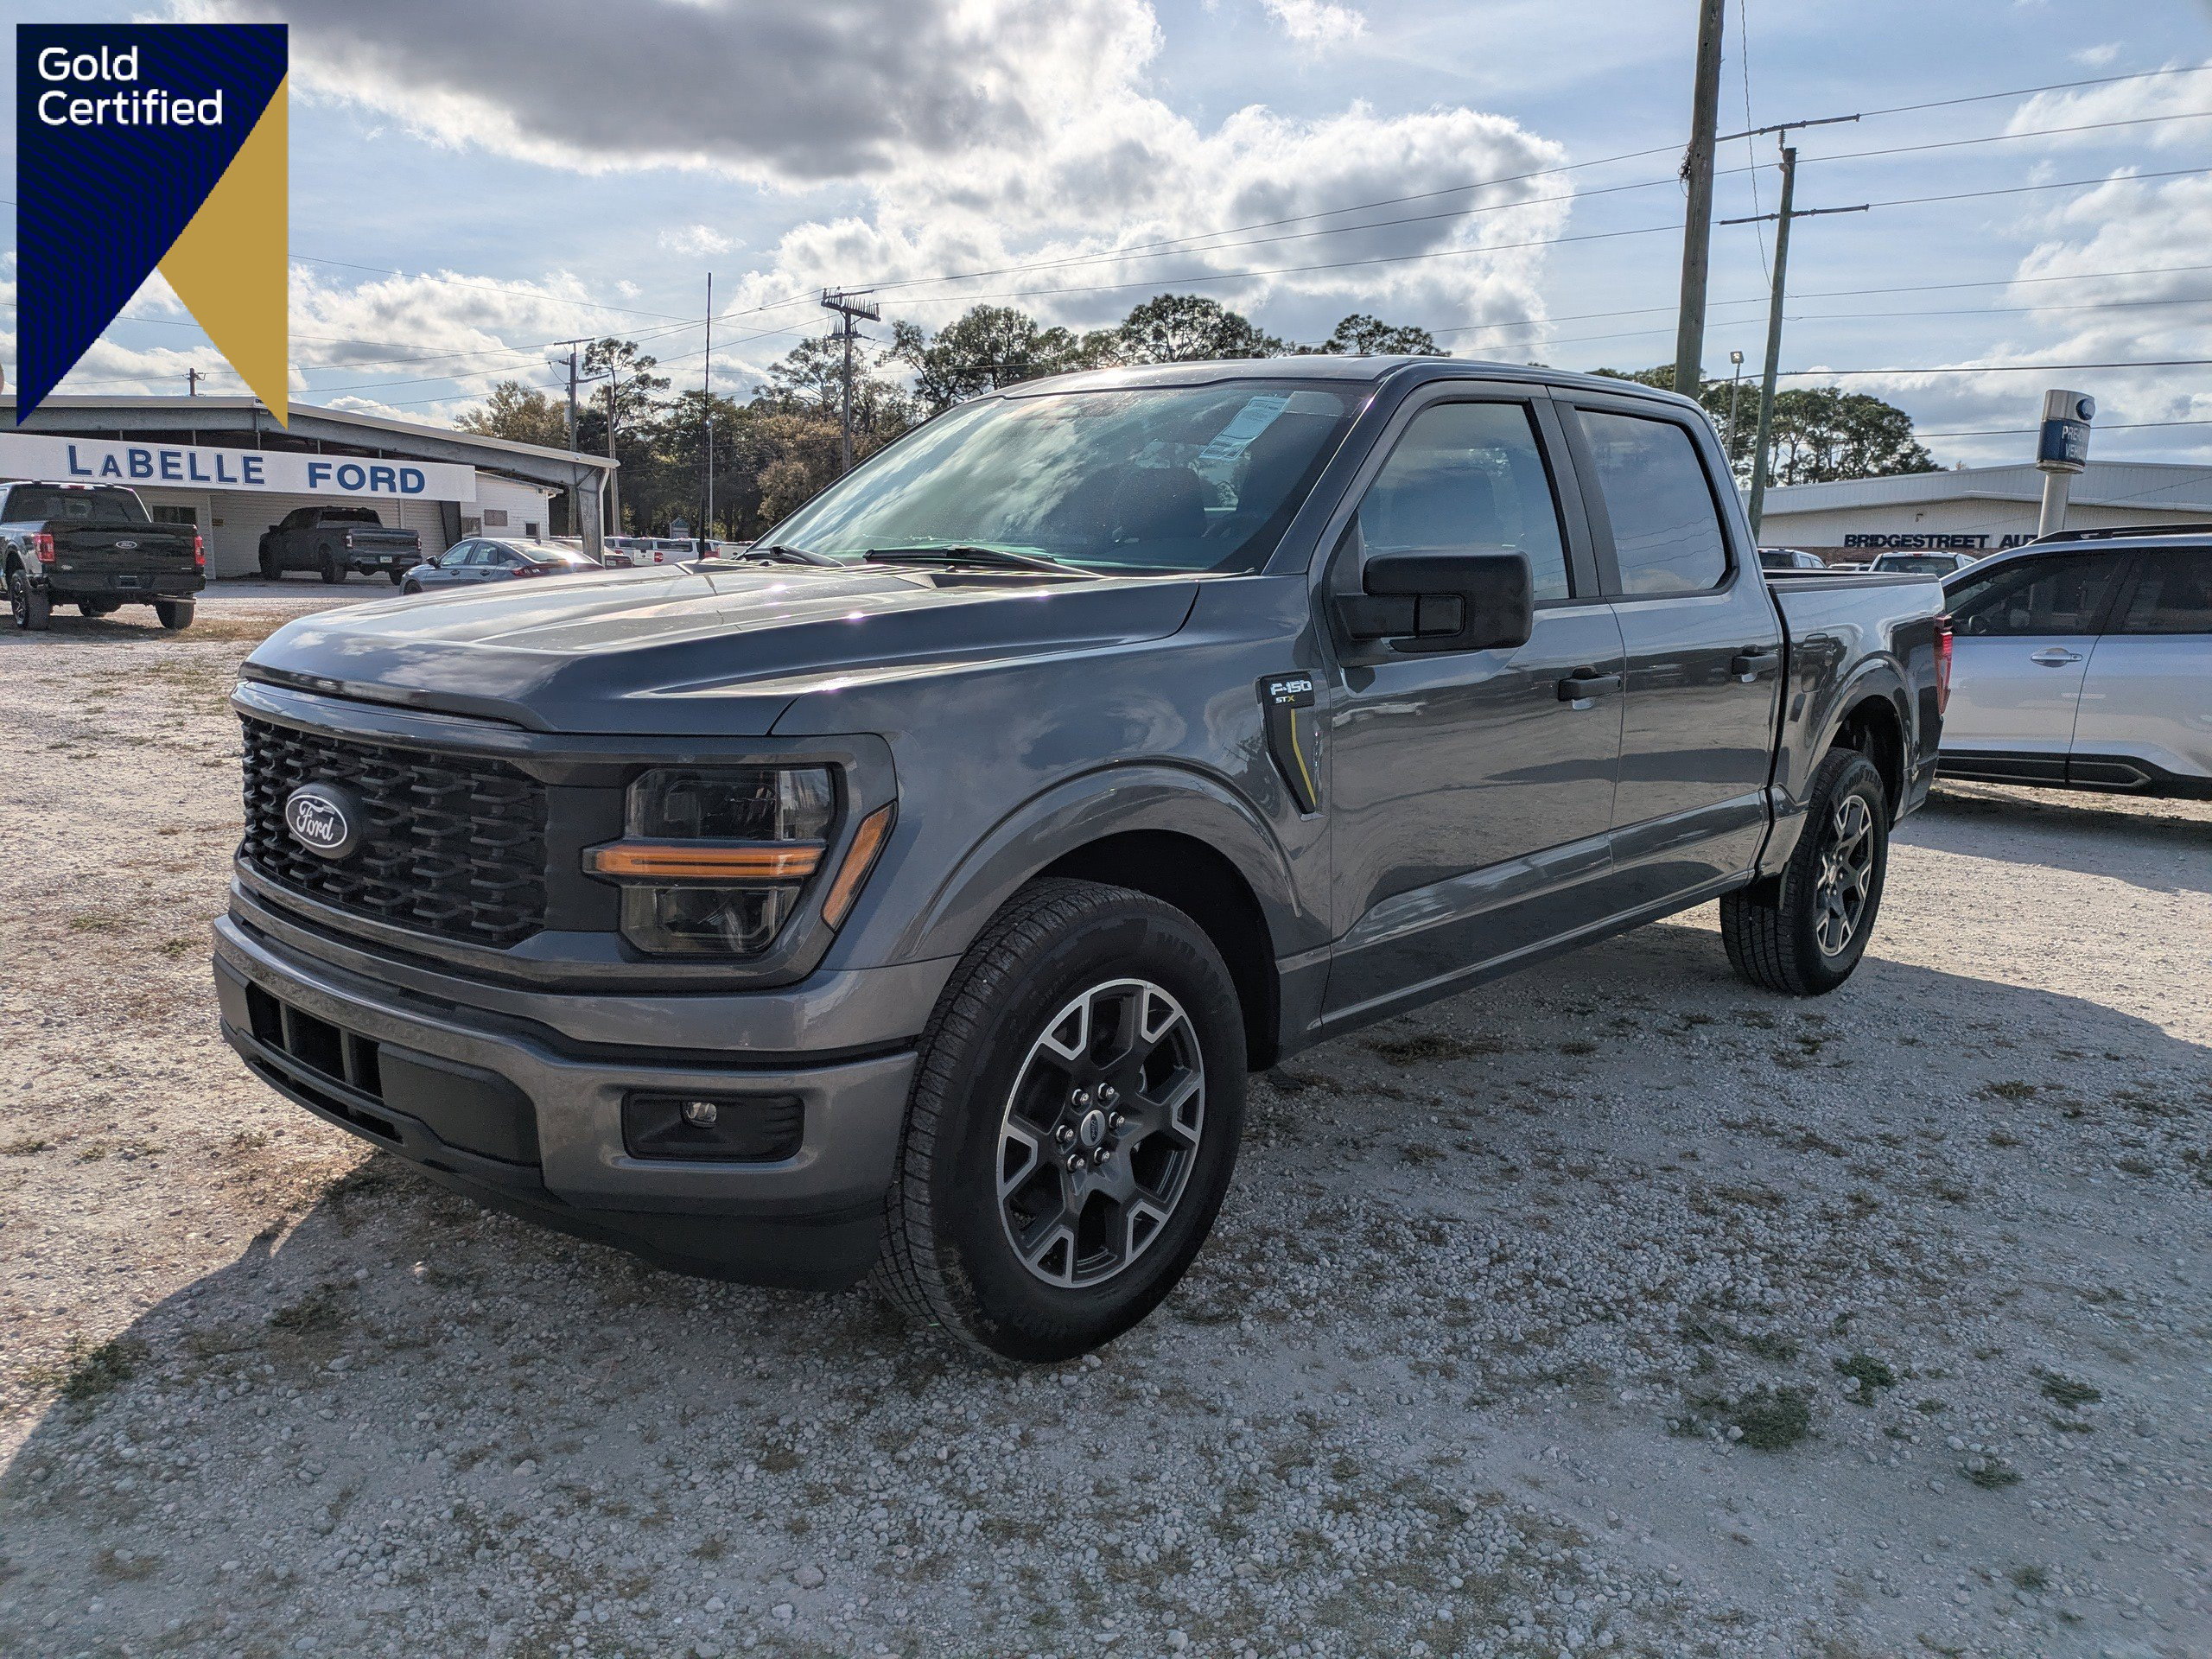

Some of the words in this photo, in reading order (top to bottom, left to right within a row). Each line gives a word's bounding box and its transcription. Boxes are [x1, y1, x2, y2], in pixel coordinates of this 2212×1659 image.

[308, 462, 426, 494] FORD
[1844, 534, 1990, 548] BRIDGESTREET
[1270, 679, 1313, 696] F-150
[1275, 695, 1295, 703] STX
[296, 800, 335, 842] Ford
